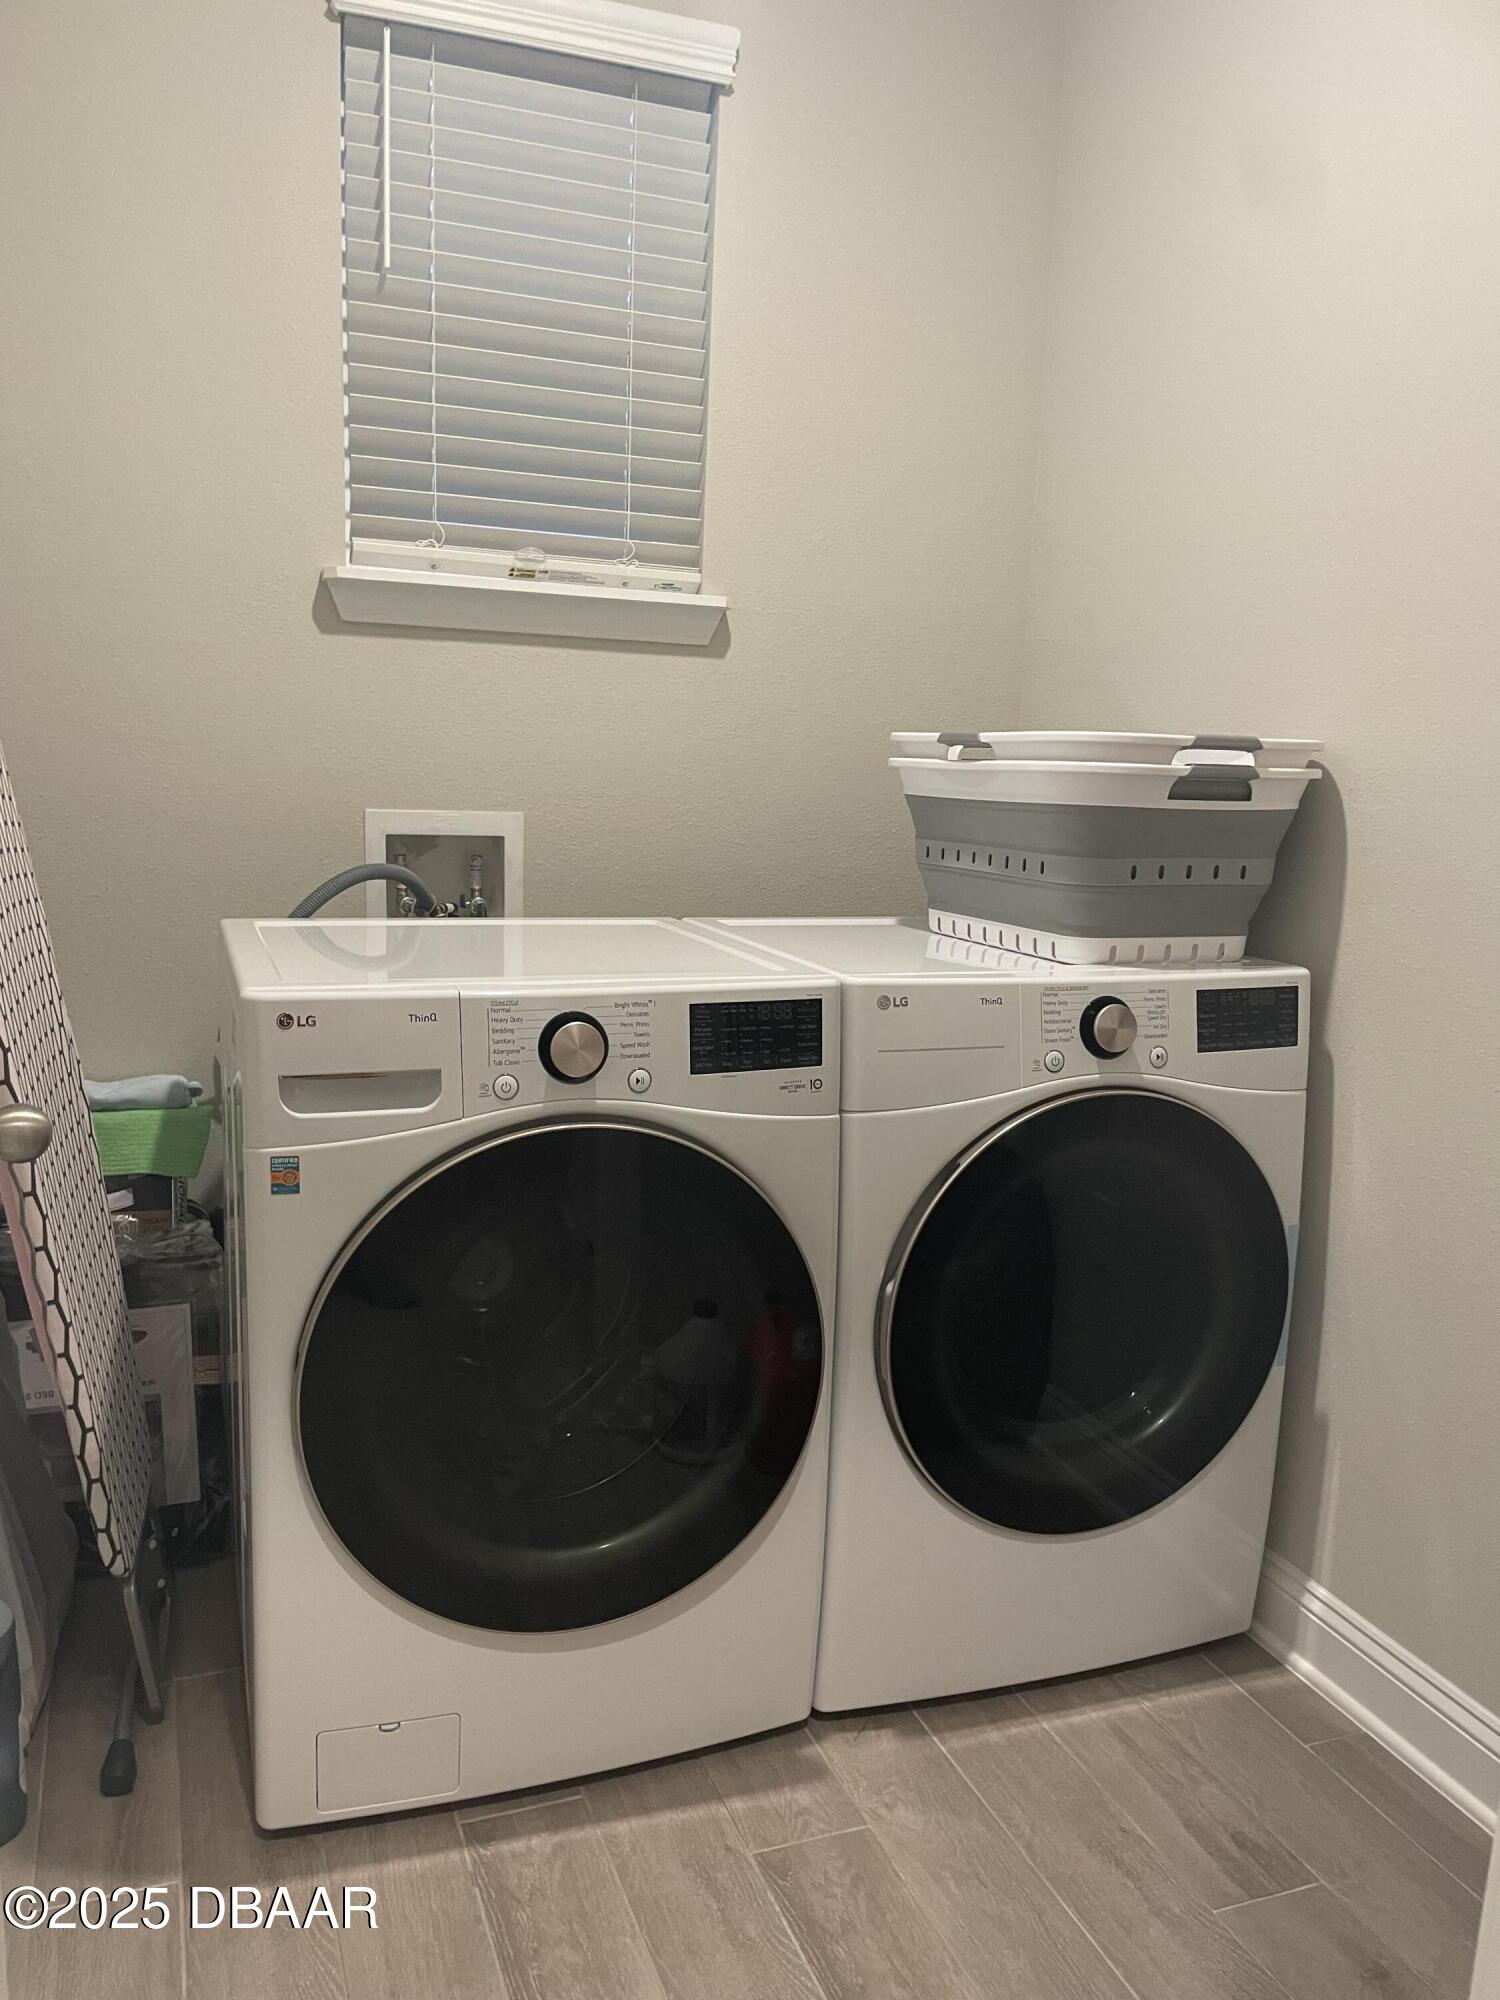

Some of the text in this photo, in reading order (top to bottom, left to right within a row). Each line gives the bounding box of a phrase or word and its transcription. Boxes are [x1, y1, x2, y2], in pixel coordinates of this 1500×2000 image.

[893, 996, 909, 1007] LG
[980, 997, 1003, 1006] ThinQ
[297, 1015, 317, 1027] LG
[408, 1012, 438, 1023] ThinQ
[491, 1027, 515, 1035] Bedding
[620, 1041, 636, 1049] Speed
[620, 1051, 651, 1059] Downloaded
